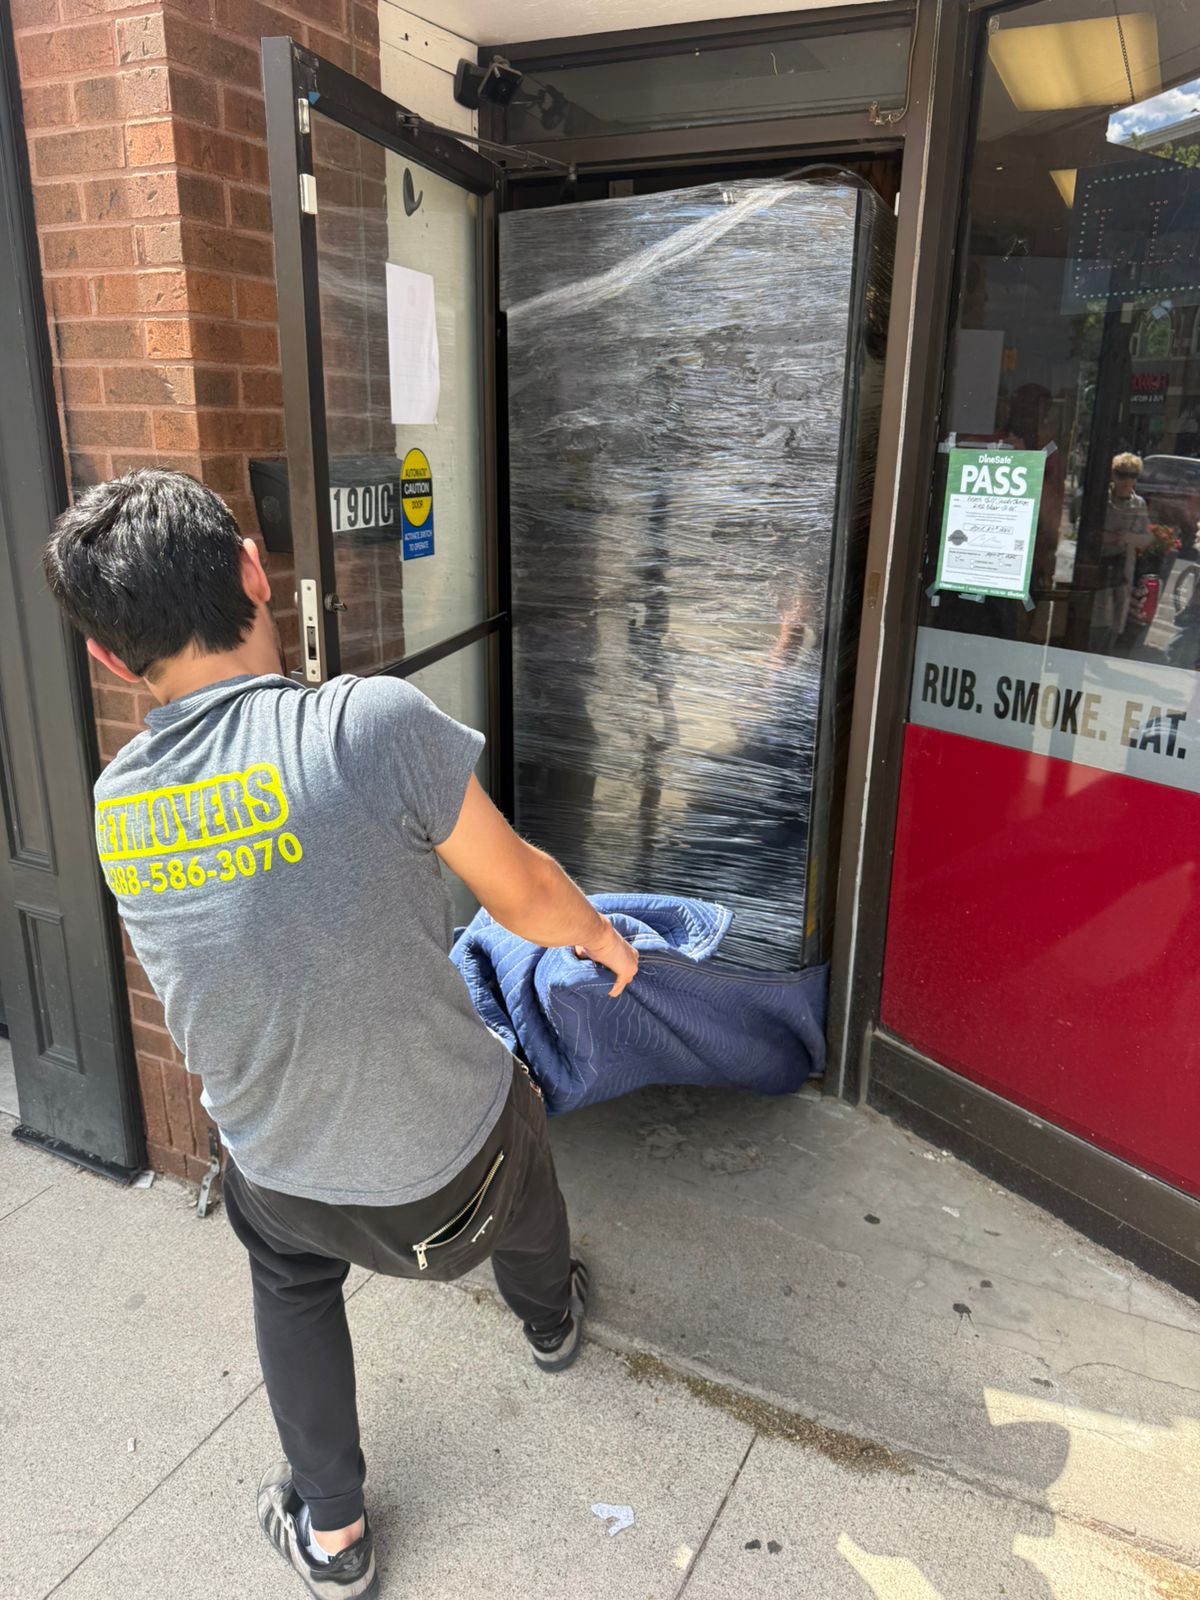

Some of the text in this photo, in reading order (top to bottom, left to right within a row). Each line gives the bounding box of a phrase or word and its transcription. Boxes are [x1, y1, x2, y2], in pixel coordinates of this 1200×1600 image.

[978, 453, 1013, 464] DineSafe
[404, 482, 430, 494] CAUTION
[960, 464, 1028, 496] PASS
[922, 662, 1187, 760] RUB. SMOKE. EAT.
